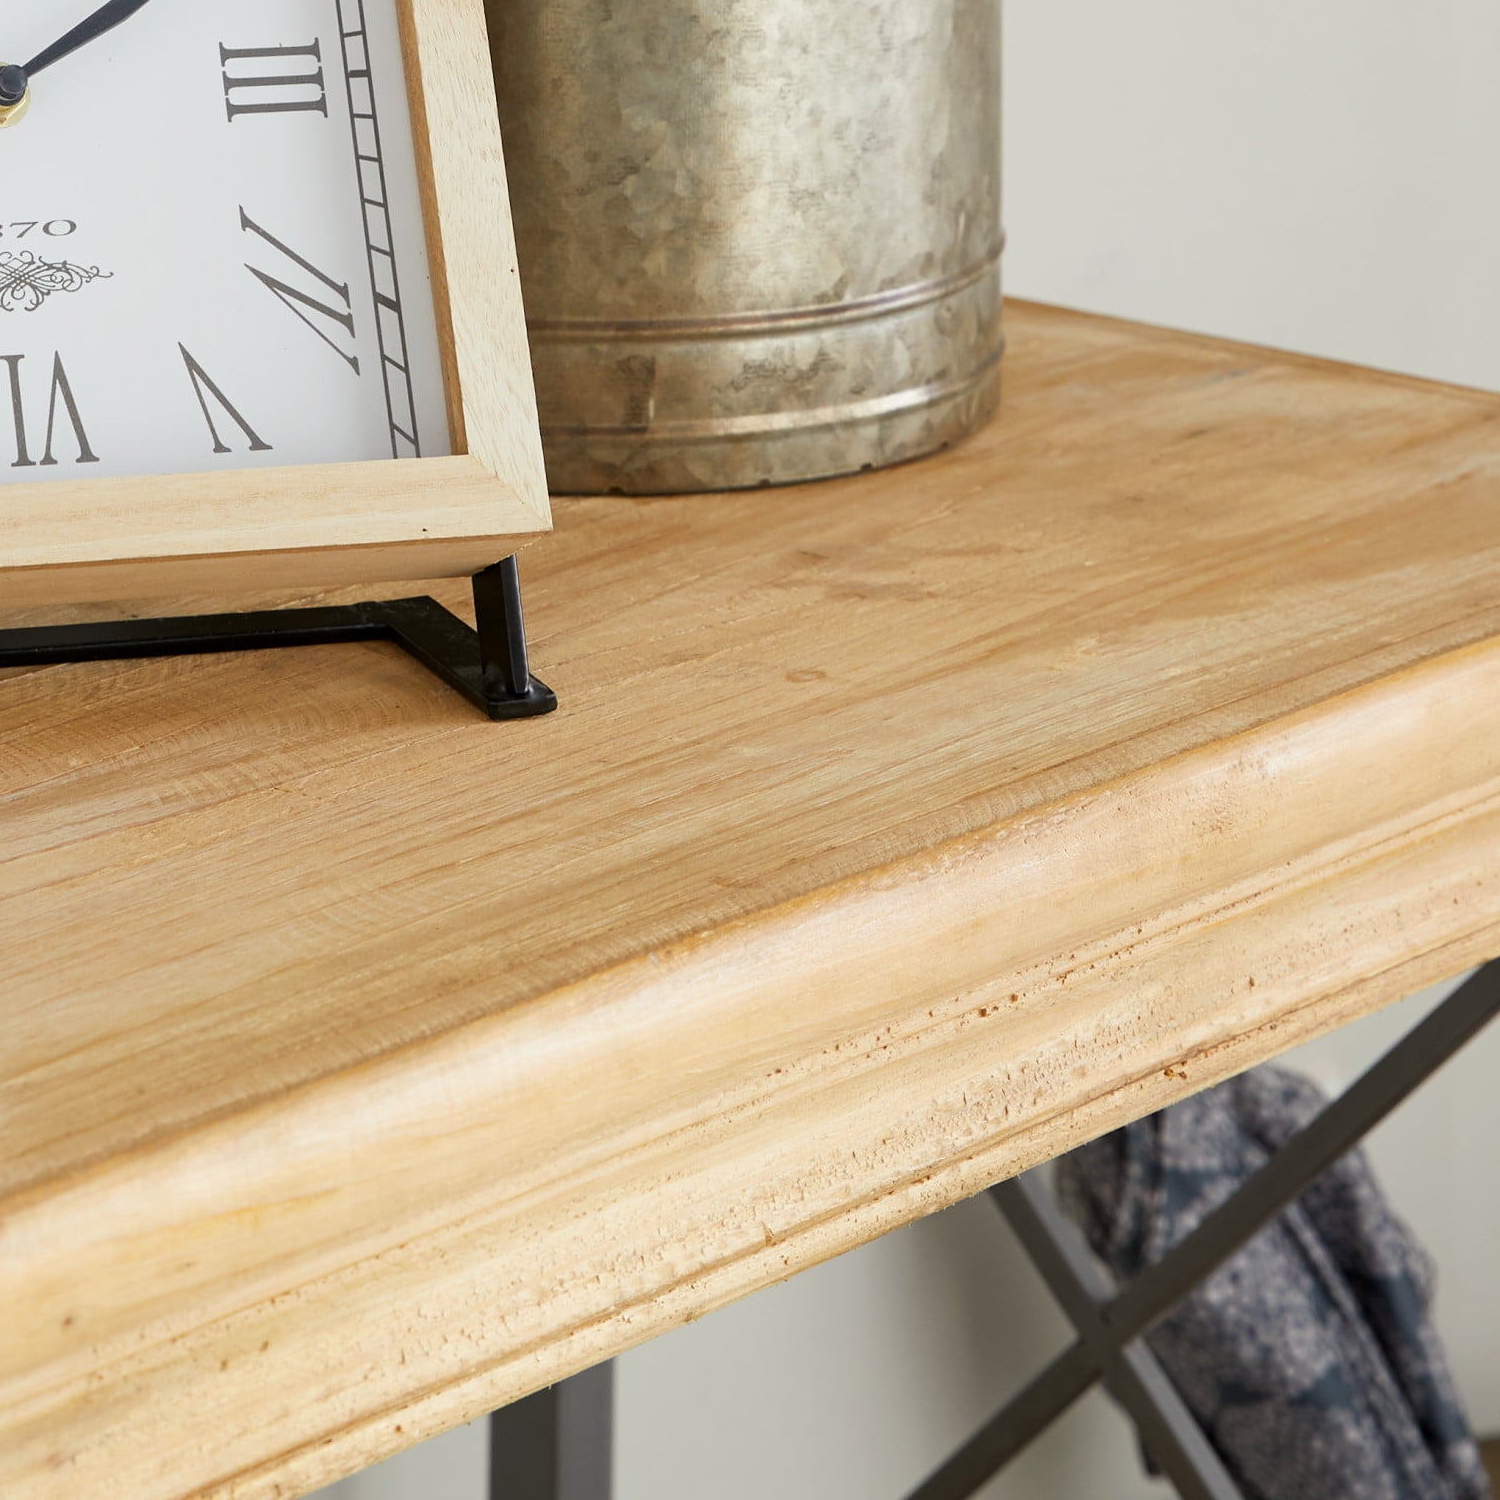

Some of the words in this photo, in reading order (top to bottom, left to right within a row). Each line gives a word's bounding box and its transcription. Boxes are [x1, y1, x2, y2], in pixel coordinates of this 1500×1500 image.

[218, 37, 328, 123] III
[239, 205, 360, 376] IV
[0, 351, 100, 467] VI
[178, 342, 273, 453] V
